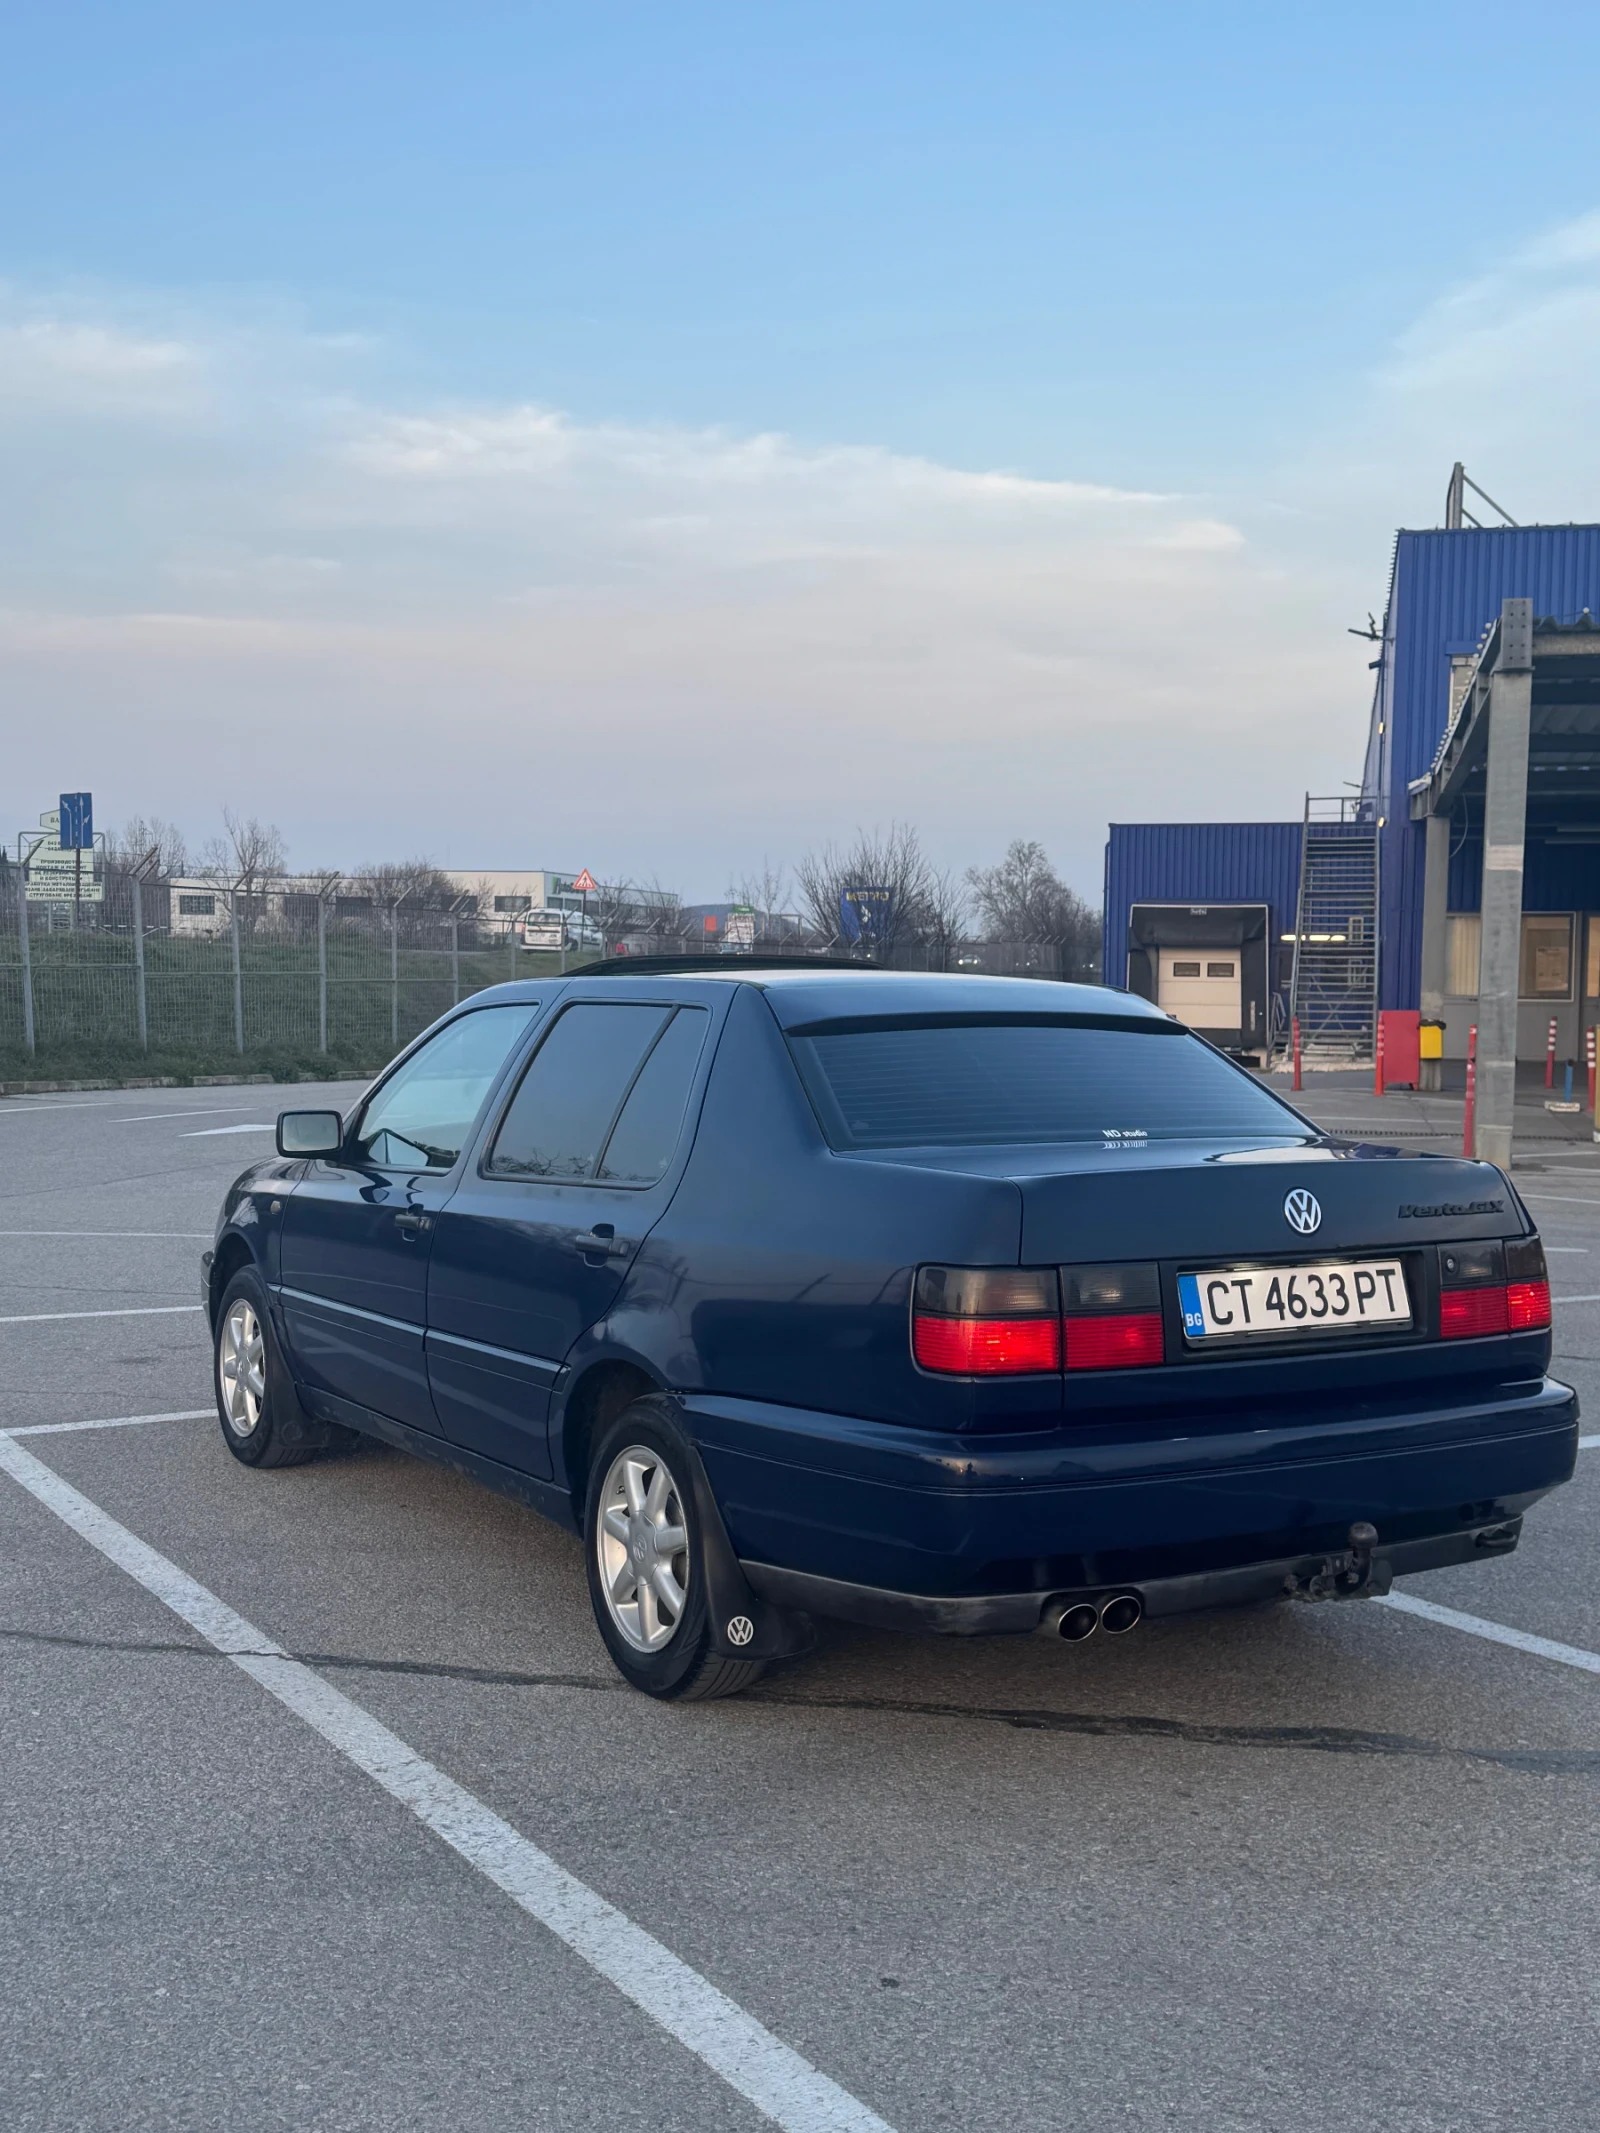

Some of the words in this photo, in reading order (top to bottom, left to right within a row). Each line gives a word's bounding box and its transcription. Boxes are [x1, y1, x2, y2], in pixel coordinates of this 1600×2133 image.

[1206, 1278, 1253, 1326] CT
[1265, 1273, 1350, 1321] 4633
[1353, 1268, 1397, 1315] PT
[1185, 1312, 1203, 1328] BG
